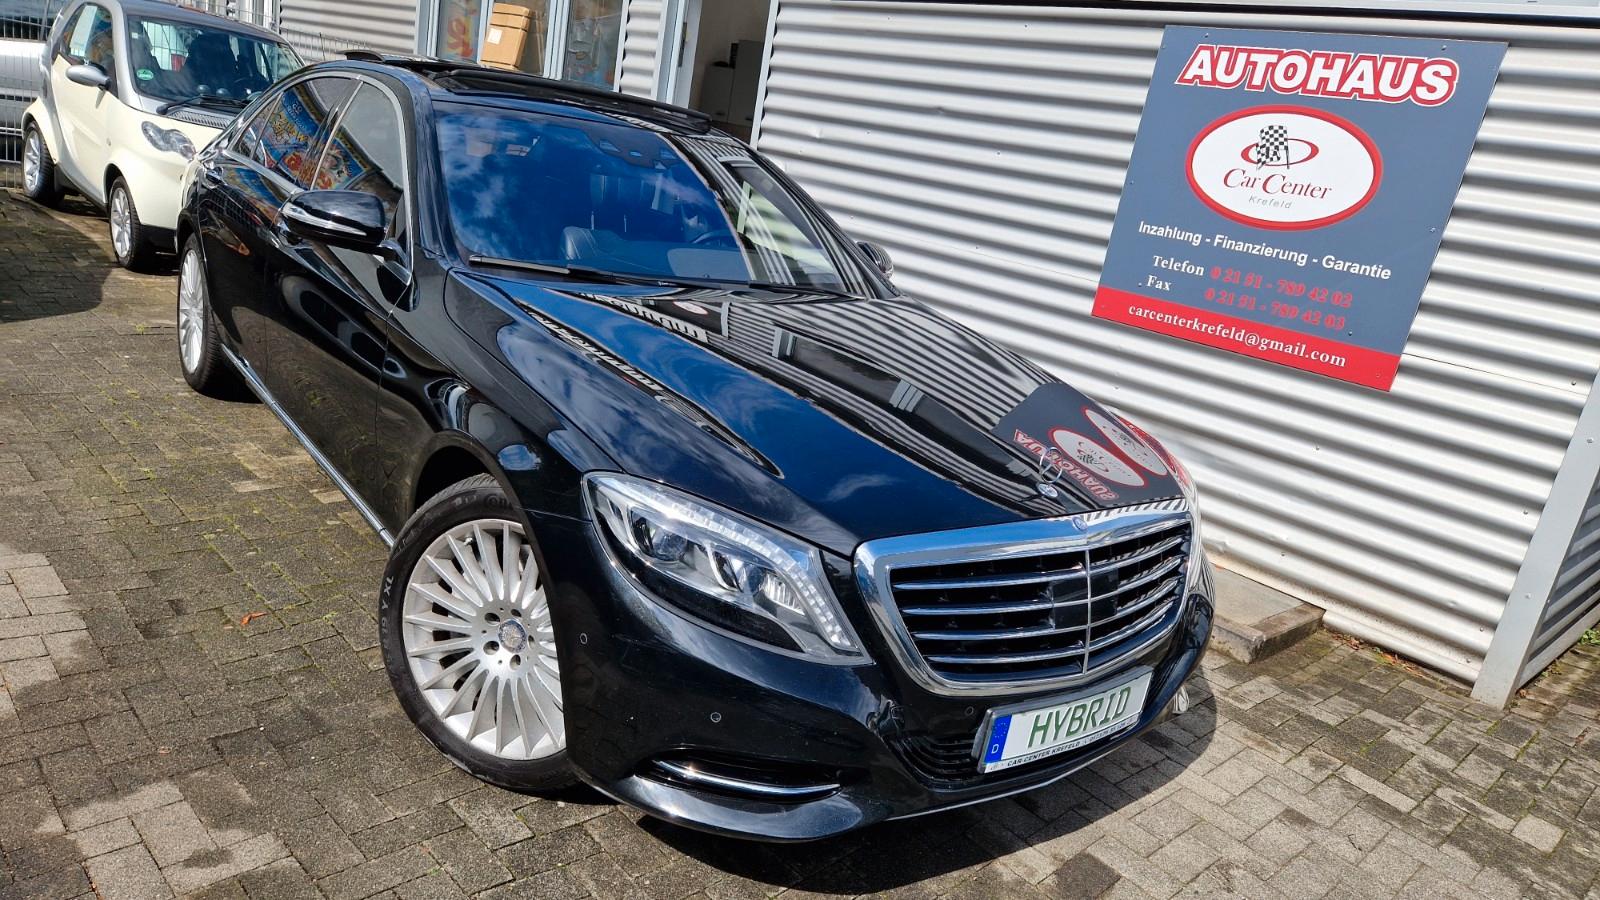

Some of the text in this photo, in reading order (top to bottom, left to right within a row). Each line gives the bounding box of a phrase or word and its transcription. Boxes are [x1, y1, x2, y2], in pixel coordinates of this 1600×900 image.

[1178, 46, 1457, 104] AUTOHAUS
[1223, 168, 1333, 199] Car Center
[1249, 195, 1291, 209] Krefeld
[1138, 221, 1202, 247] Inzahlung
[1213, 234, 1309, 267] Finanzierung
[1321, 254, 1392, 280] Garantie
[1146, 274, 1172, 291] Fax
[1216, 290, 1234, 306] 21
[1302, 310, 1322, 326] 42
[1153, 255, 1205, 276] Telefon
[1223, 267, 1241, 284] 21
[1308, 287, 1328, 303] 42
[1128, 304, 1346, 368] carcenterkrefeld@gmail.com
[383, 576, 394, 597] XL
[1028, 686, 1132, 748] HYBRID
[991, 743, 1000, 754] D
[1051, 741, 1081, 755] KREFELD
